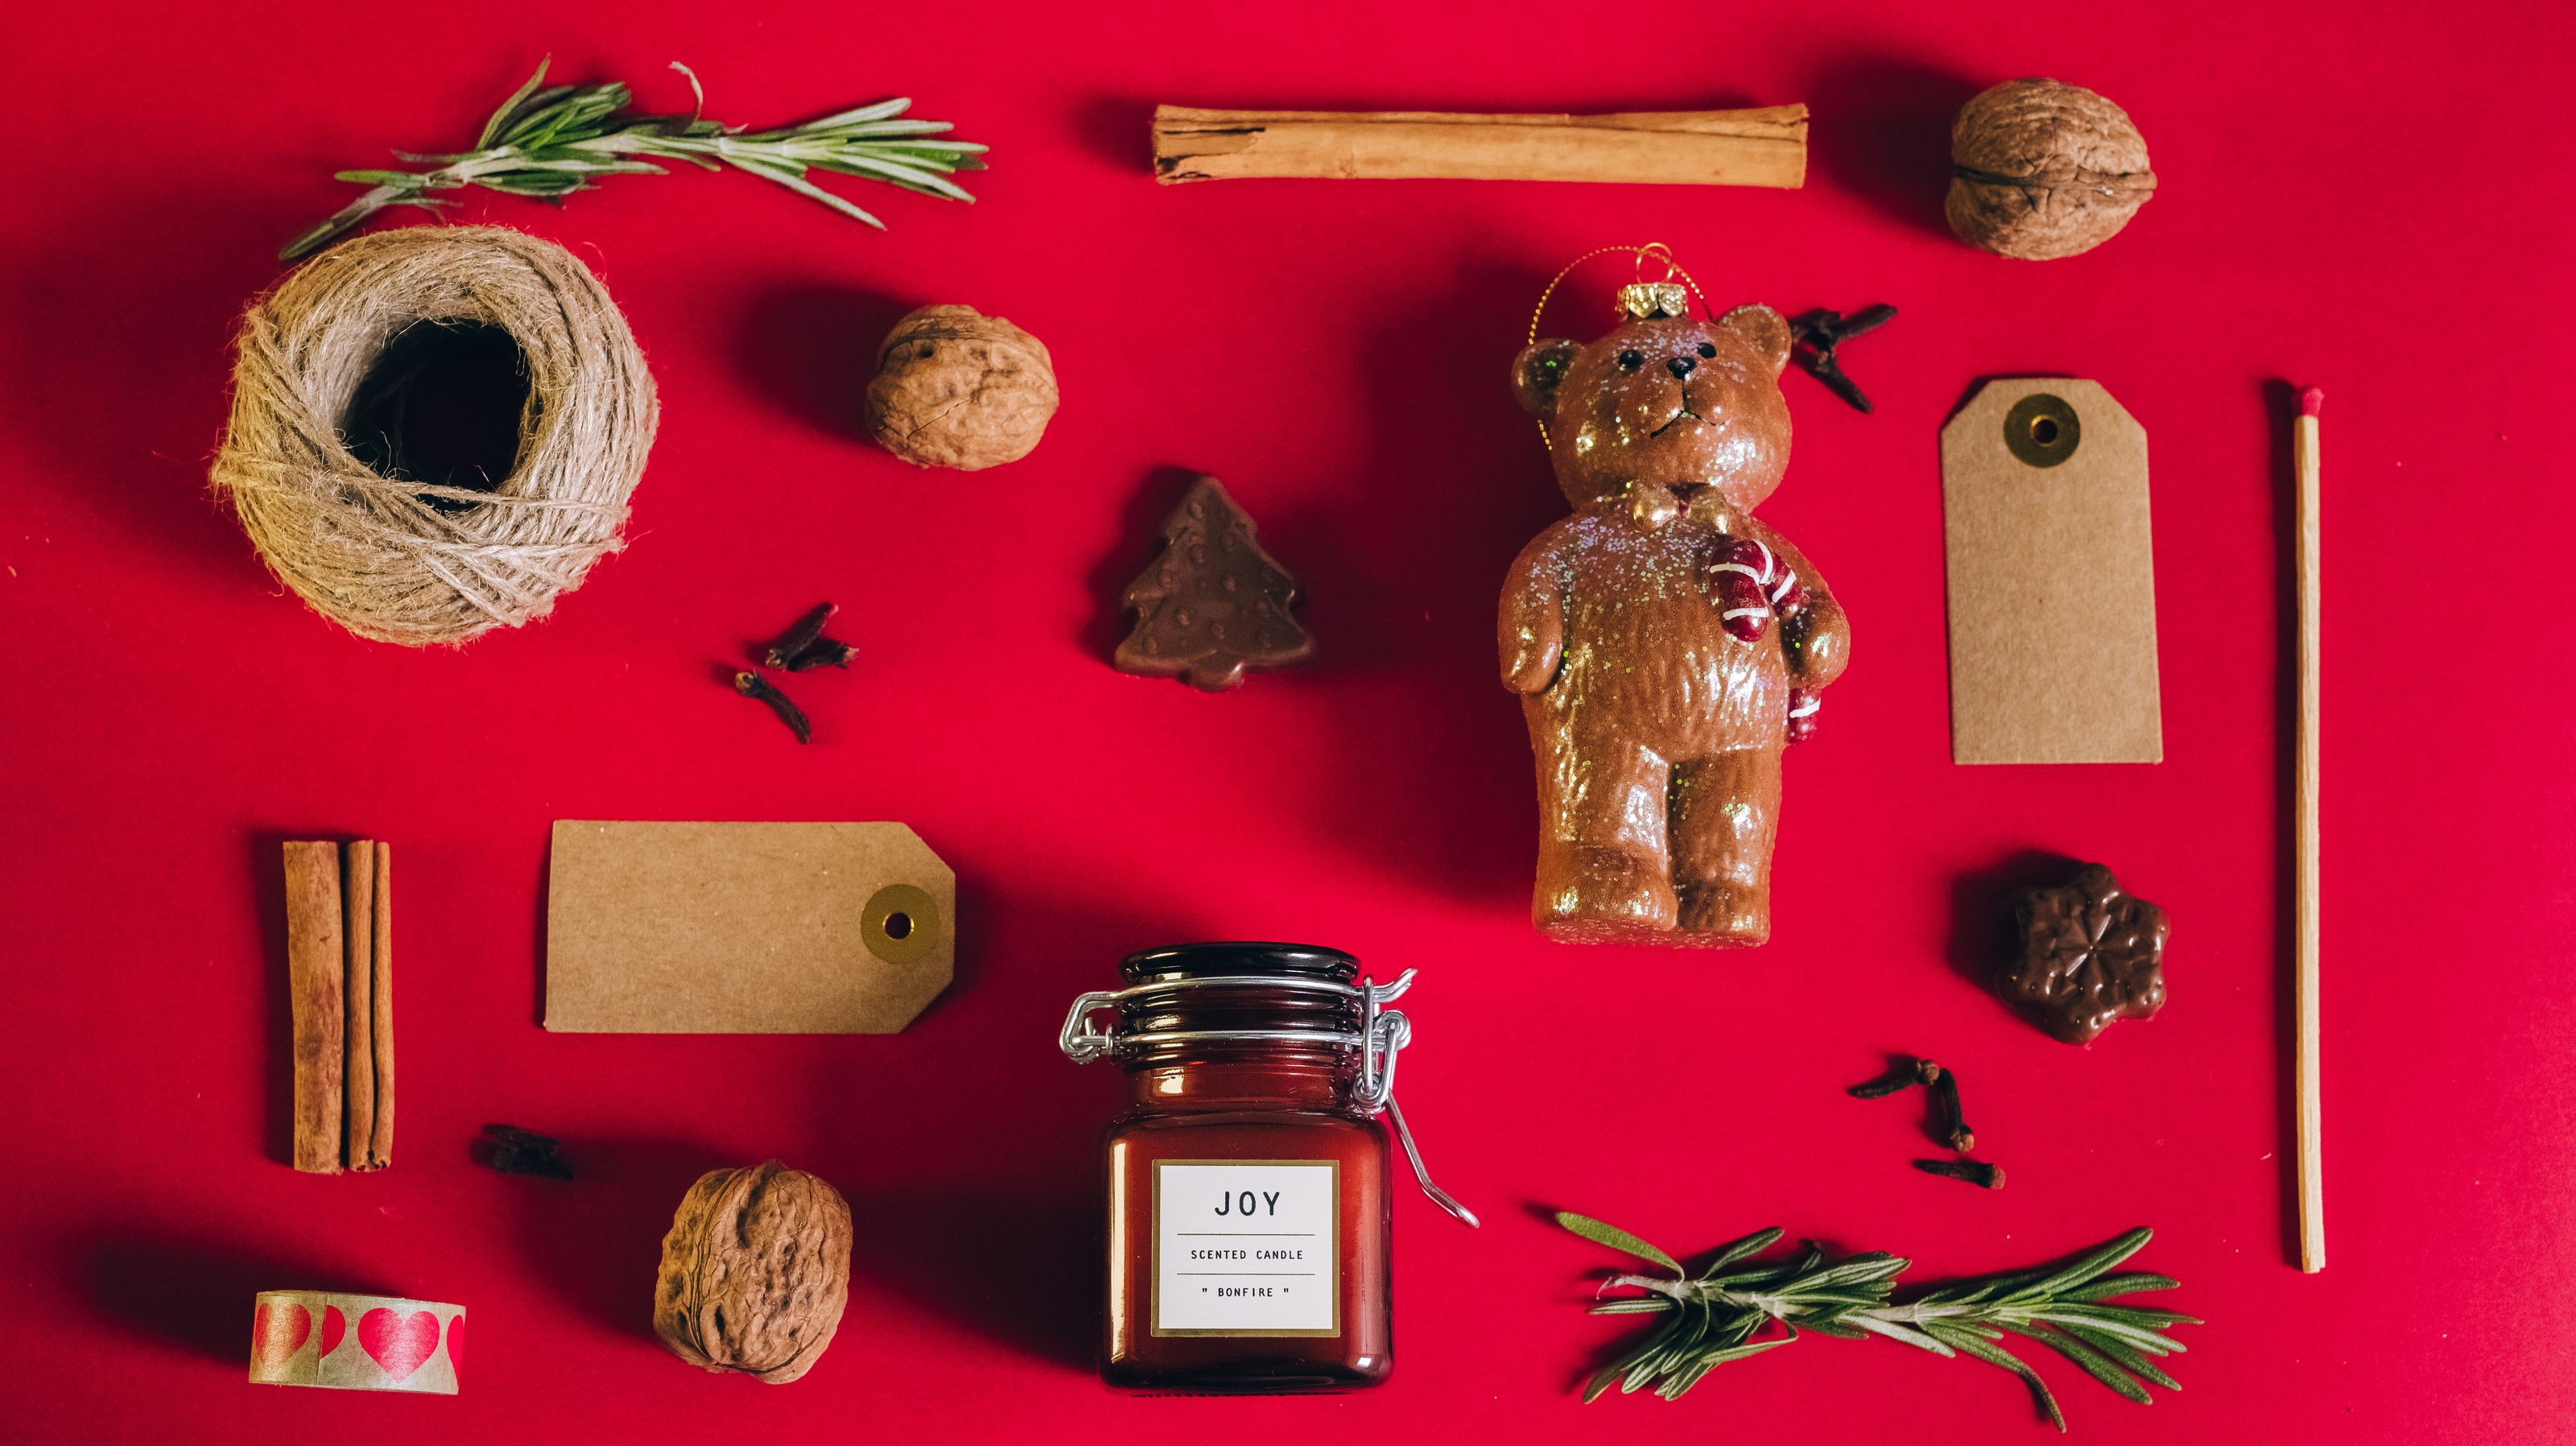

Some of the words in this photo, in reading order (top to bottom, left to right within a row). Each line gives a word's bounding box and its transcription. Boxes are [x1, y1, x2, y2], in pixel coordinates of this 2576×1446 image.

[1214, 1190, 1280, 1217] JOY
[1191, 1250, 1247, 1260] SCENTED
[1256, 1250, 1303, 1260] CANDLE
[1218, 1287, 1274, 1297] BONFIRE
